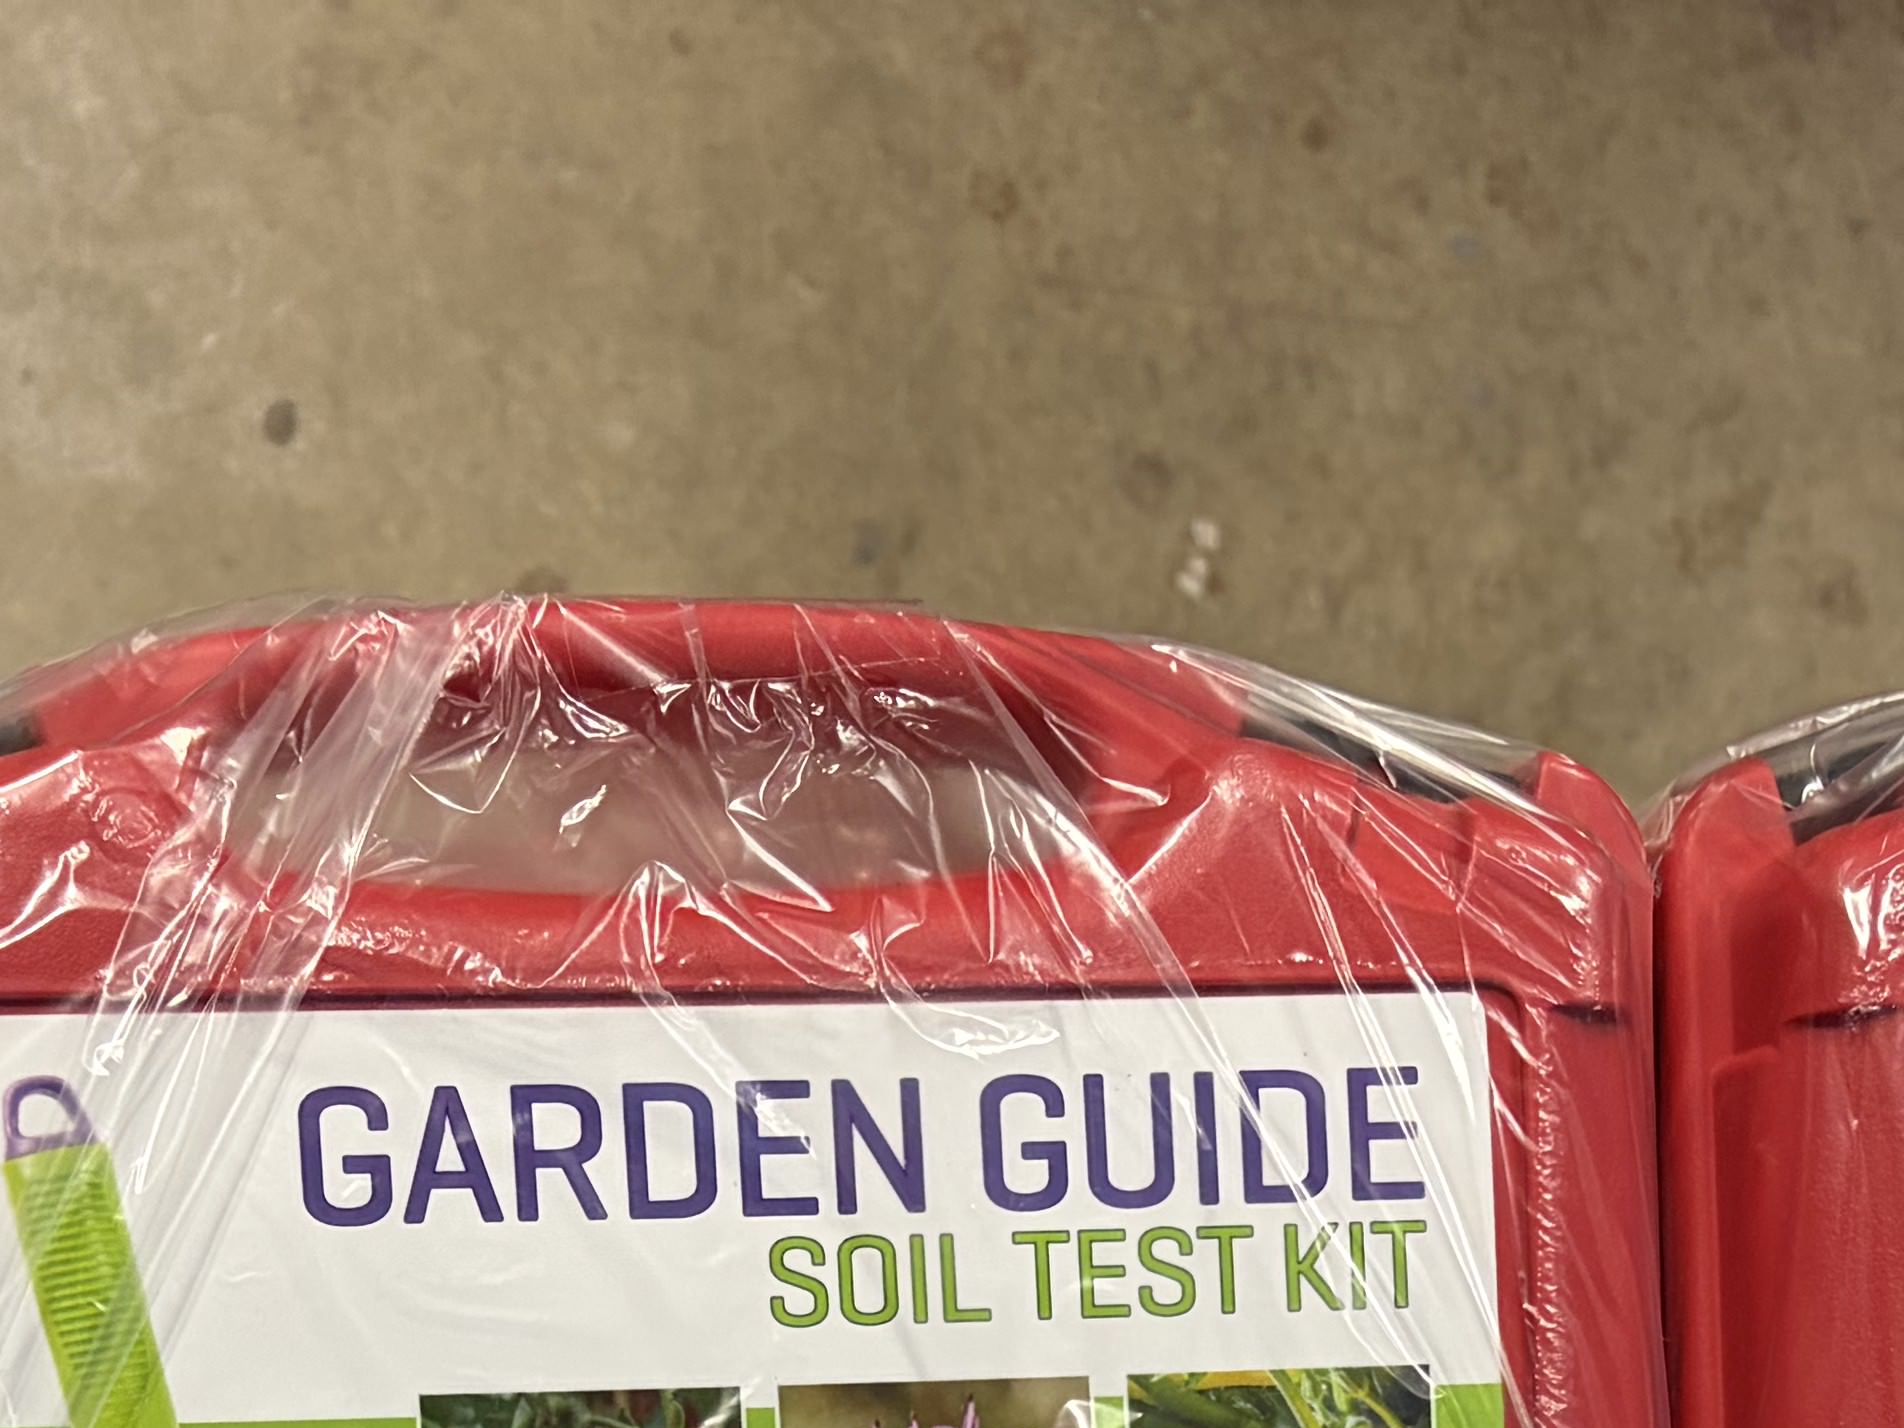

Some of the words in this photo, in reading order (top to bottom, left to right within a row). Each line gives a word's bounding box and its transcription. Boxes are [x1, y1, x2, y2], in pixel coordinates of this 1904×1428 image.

[298, 1078, 925, 1227] GARDEN
[981, 1066, 1426, 1212] GUIDE
[767, 1233, 992, 1329] SOIL
[1012, 1226, 1254, 1320] TEST
[1284, 1219, 1426, 1312] KIT
